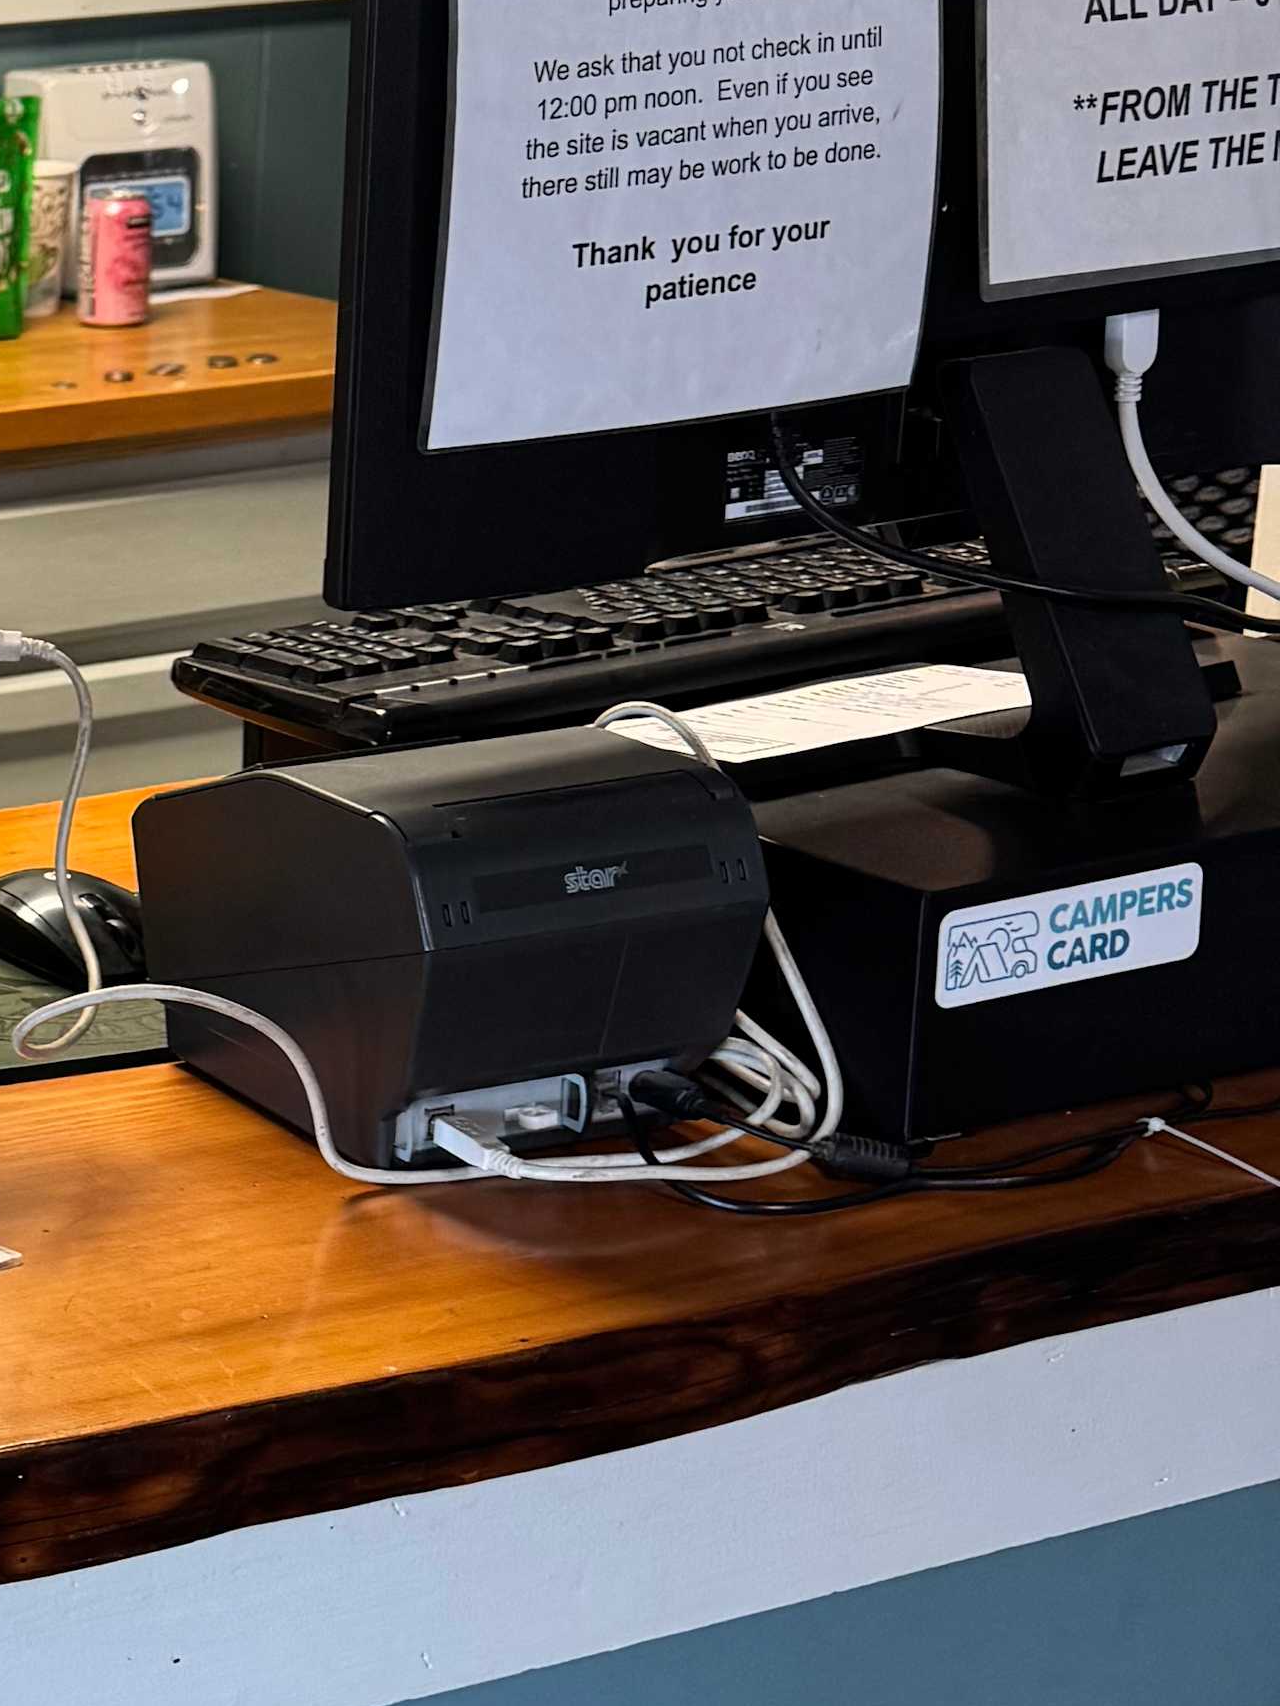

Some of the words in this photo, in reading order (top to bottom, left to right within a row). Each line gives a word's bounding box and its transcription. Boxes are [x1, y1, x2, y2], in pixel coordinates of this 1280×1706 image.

[534, 59, 570, 83] We
[577, 54, 615, 79] ask
[621, 50, 662, 74] that
[668, 49, 706, 75] you
[713, 41, 745, 64] not
[752, 33, 811, 60] check
[818, 32, 834, 53] in
[842, 25, 882, 51] until
[538, 94, 597, 121] 12:00
[604, 95, 637, 120] pm
[644, 88, 703, 109] noon.
[718, 79, 769, 101] Even
[776, 72, 789, 95] if
[793, 73, 830, 99] you
[837, 69, 873, 88] see
[1201, 76, 1259, 113] THE
[526, 138, 560, 160] the
[566, 133, 604, 155] site
[611, 129, 628, 151] is
[636, 120, 706, 148] vacant
[712, 115, 767, 139] when
[774, 113, 811, 138] you
[818, 103, 879, 128] arrive,
[522, 176, 578, 199] there
[584, 167, 619, 191] still
[627, 166, 673, 189] may
[679, 158, 705, 180] be
[712, 151, 761, 176] work
[767, 150, 787, 170] to
[793, 146, 818, 167] be
[825, 141, 880, 163] done.
[1096, 139, 1200, 183] LEAVE
[1208, 132, 1266, 169] THE
[572, 236, 656, 268] Thank
[671, 233, 720, 263] you
[728, 224, 766, 250] for
[771, 220, 831, 251] your
[645, 272, 756, 309] patience
[564, 866, 619, 892] star
[1048, 878, 1193, 934] CAMPERS
[1047, 929, 1130, 970] CARD
